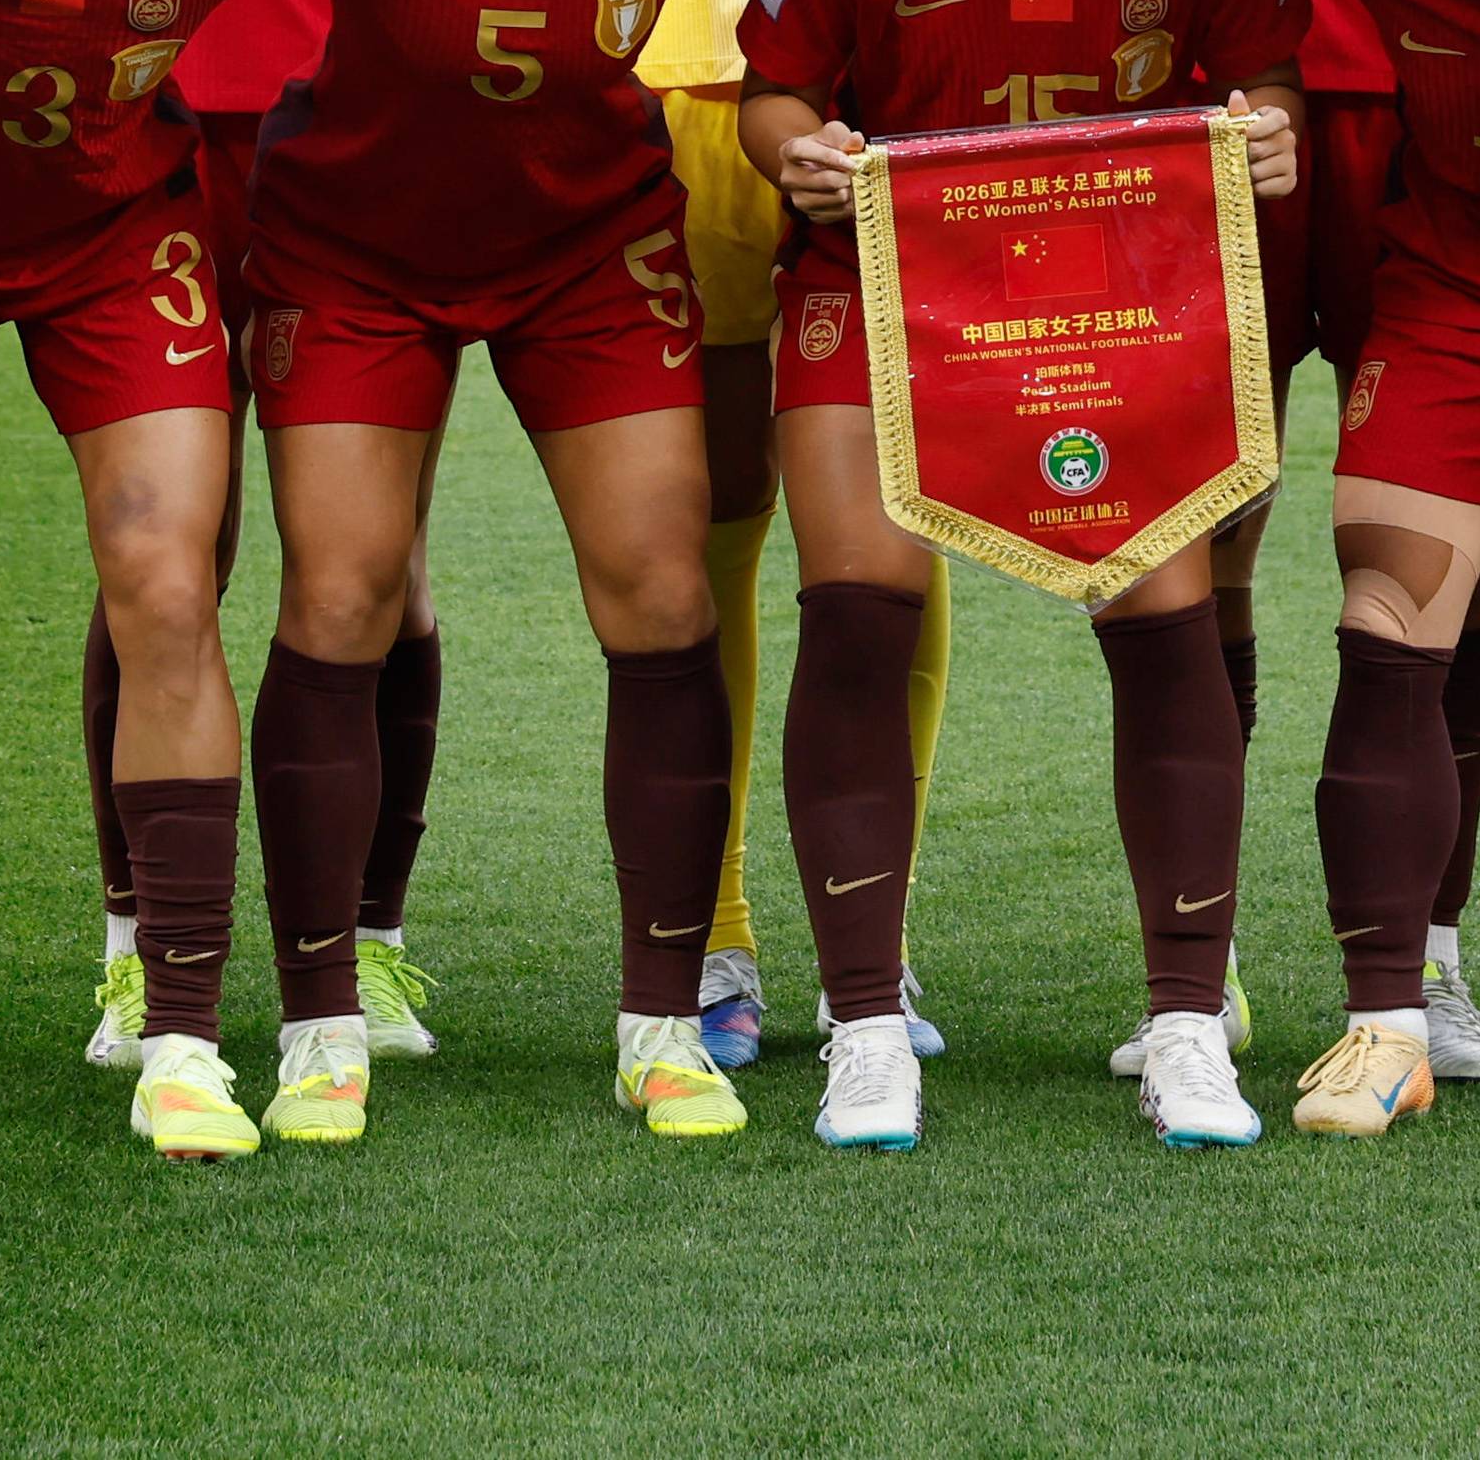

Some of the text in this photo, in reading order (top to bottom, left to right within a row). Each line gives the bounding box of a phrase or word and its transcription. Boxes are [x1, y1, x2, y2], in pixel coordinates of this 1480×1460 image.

[470, 8, 547, 102] 5
[2, 65, 77, 148] 3
[942, 167, 1153, 203] 2026亚足联女足亚洲杯
[943, 190, 1157, 222] AFC Women's Asian Cup
[150, 230, 207, 328] 3
[623, 229, 690, 329] 5
[808, 297, 846, 310] CFA
[961, 306, 1160, 345] 中国国家女子足球队
[944, 332, 1183, 364] CHINA WOMEN'S NATIONAL FOOTBALL TEAM
[1053, 398, 1084, 412] Semi
[1087, 395, 1124, 409] Finals
[1059, 380, 1111, 394] Stadium
[1066, 467, 1085, 477] CFA
